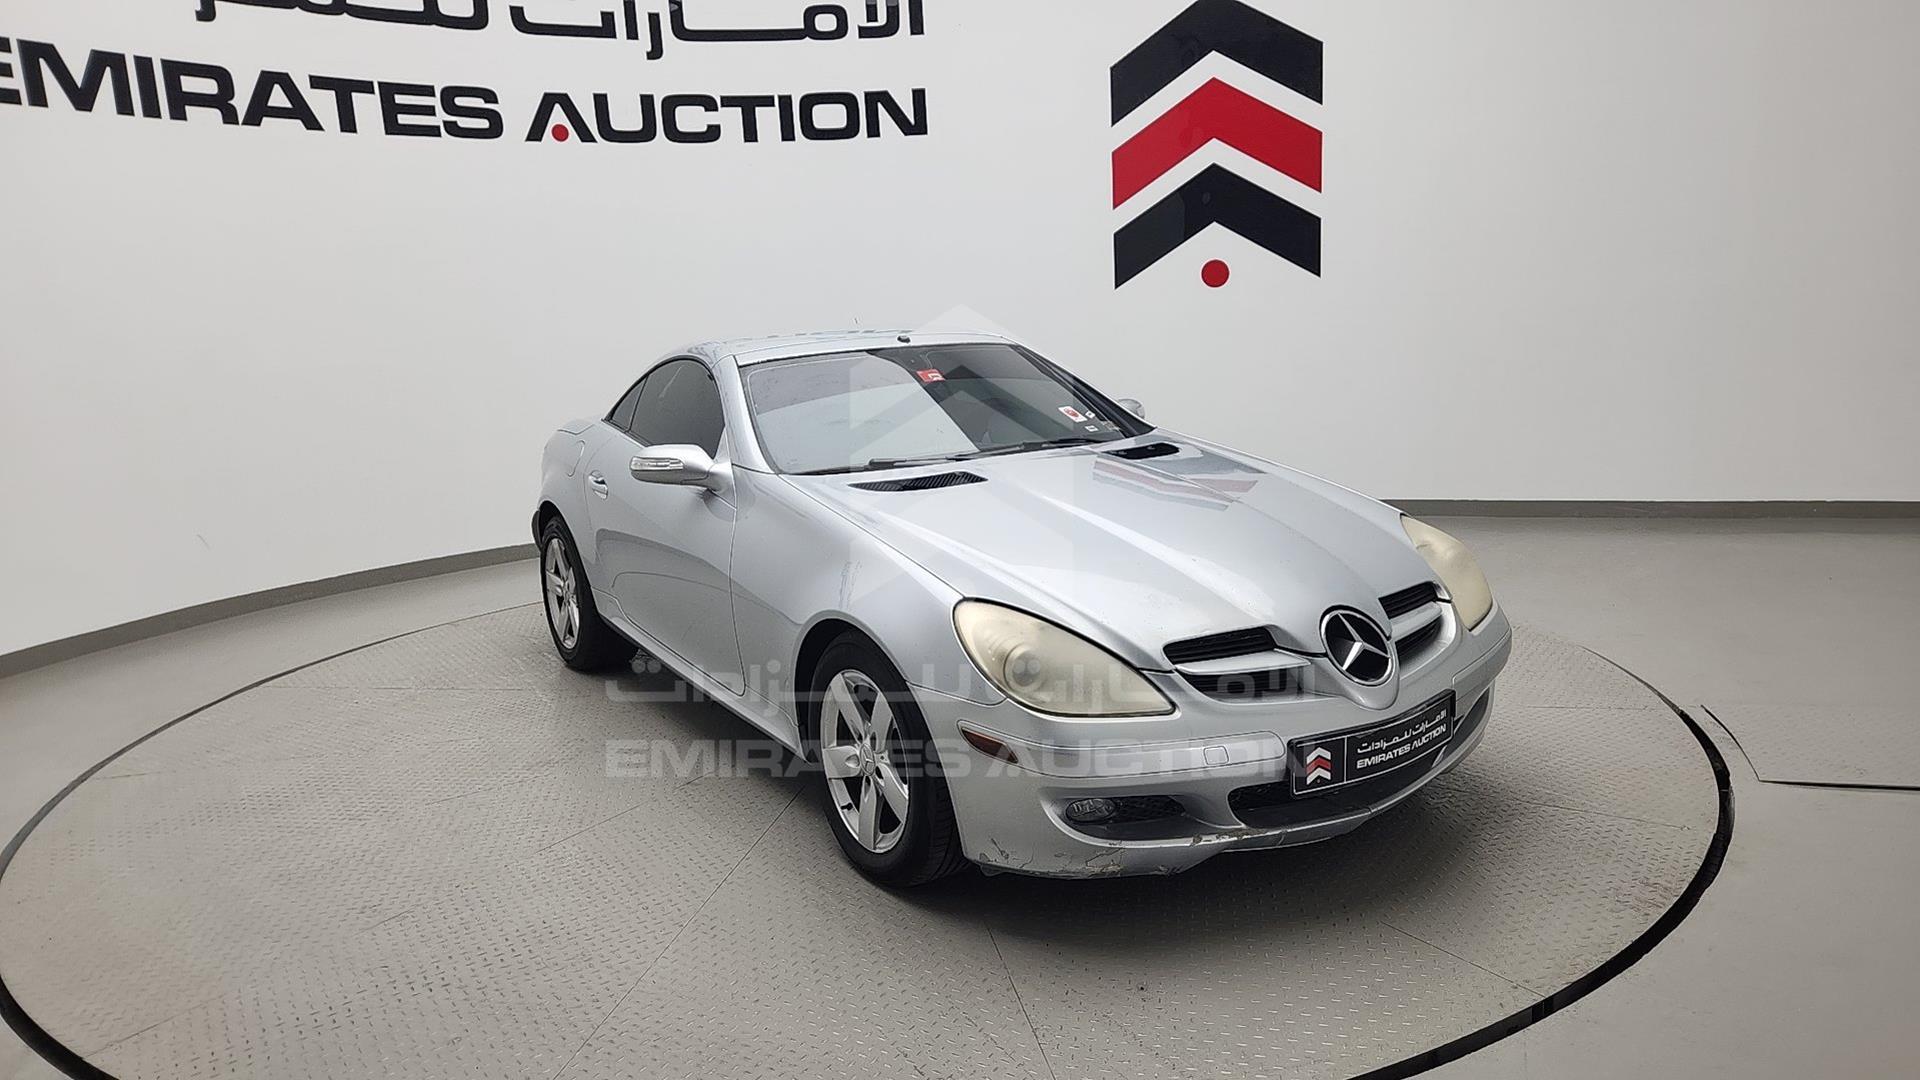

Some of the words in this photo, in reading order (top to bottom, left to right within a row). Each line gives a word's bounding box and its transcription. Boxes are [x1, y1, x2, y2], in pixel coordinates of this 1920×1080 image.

[525, 88, 928, 144] AUCTION
[1356, 743, 1411, 769] EMIRATES
[1411, 723, 1446, 751] AUCTION
